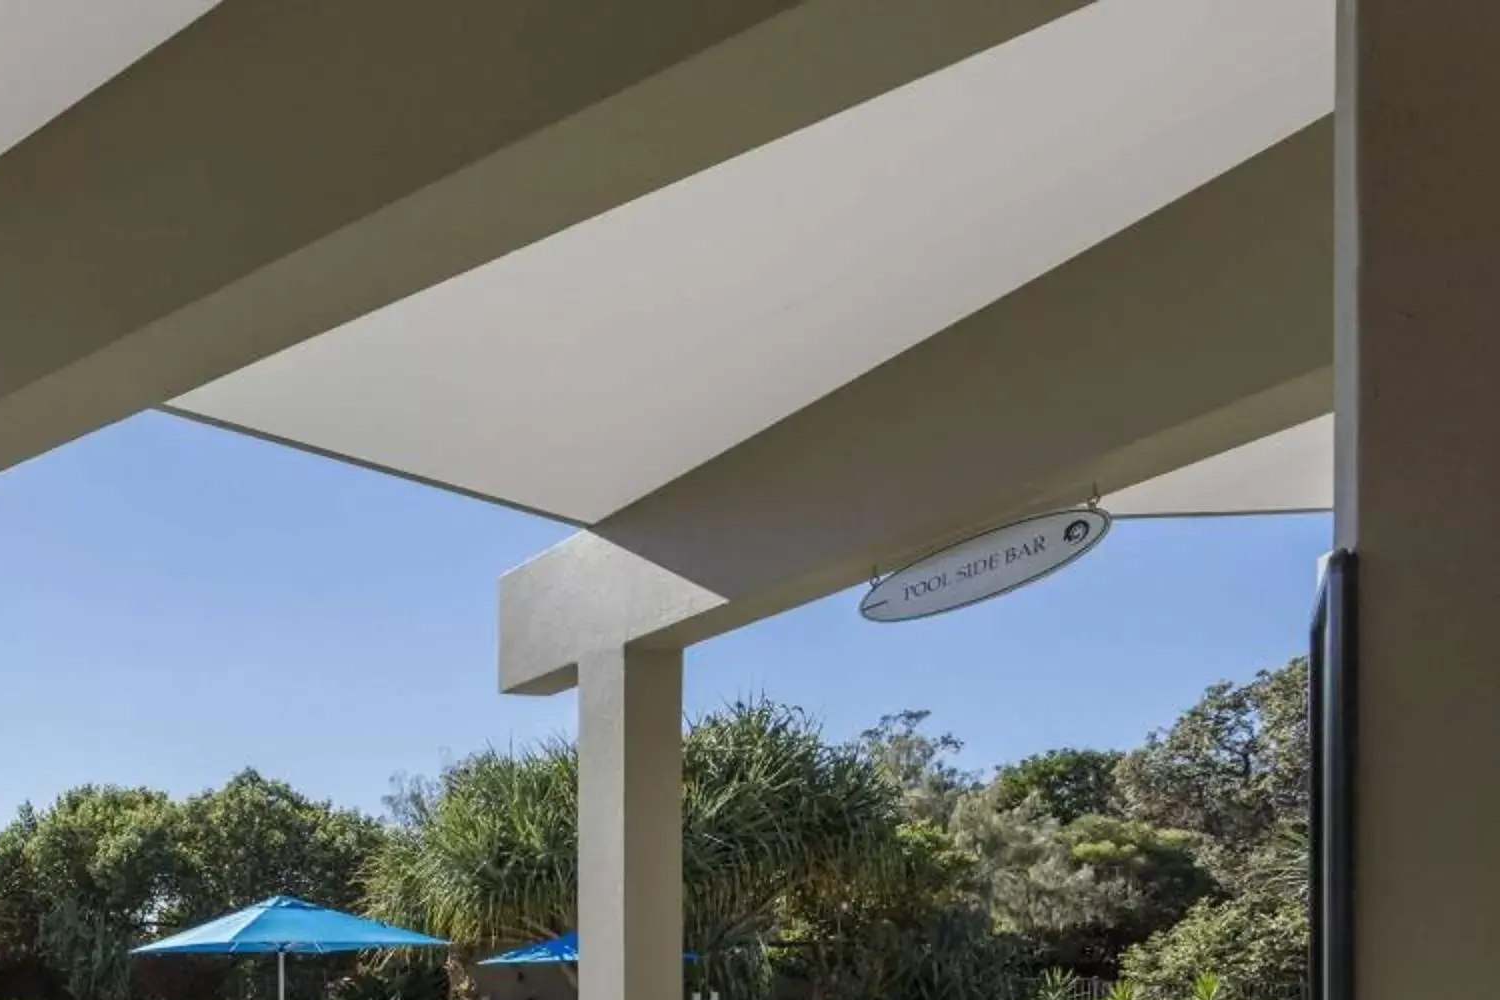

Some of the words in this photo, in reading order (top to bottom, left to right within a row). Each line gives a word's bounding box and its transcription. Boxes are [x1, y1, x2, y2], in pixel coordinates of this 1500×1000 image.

[902, 572, 950, 601] POOL
[956, 553, 1000, 581] SIDE
[1004, 534, 1047, 564] BAR
